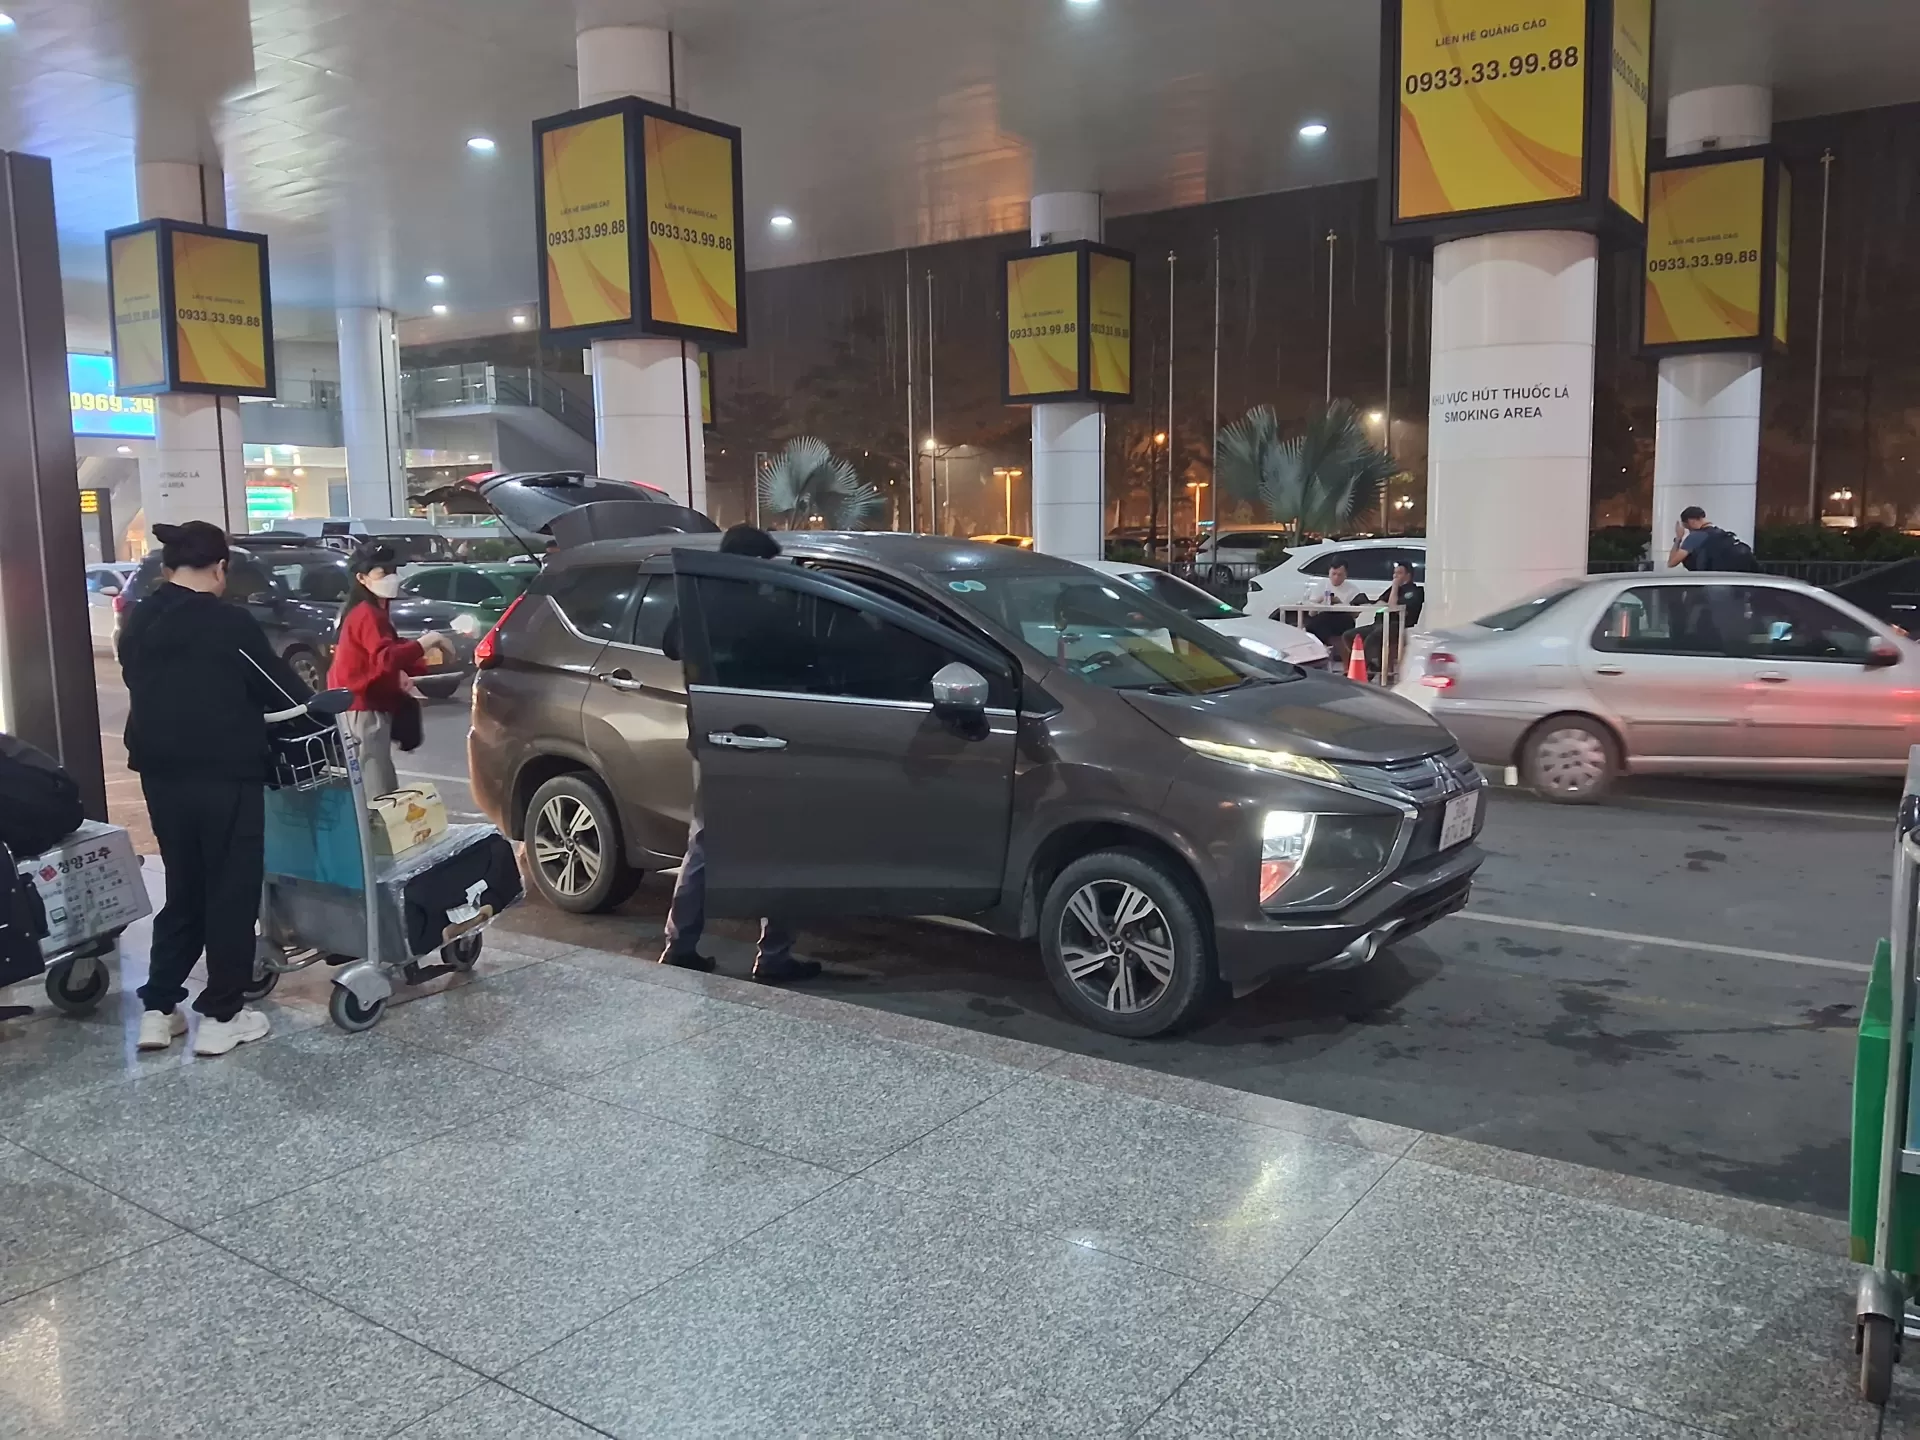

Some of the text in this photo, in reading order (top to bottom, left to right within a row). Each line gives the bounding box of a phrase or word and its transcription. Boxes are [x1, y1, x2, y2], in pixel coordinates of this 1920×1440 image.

[1405, 46, 1579, 94] 0933.33.99.88
[548, 219, 625, 246] 0933.33.99.88
[650, 220, 732, 251] 0933.33.99.88
[1649, 249, 1758, 272] 0933.33.99.88
[178, 308, 260, 327] 0933.33.99.88
[1010, 322, 1076, 340] 0933.33.99.88
[1446, 390, 1468, 406] VỰC
[1472, 386, 1499, 402] HÚT
[1502, 382, 1550, 400] THUỐC
[1444, 406, 1543, 423] SMOKING AREA
[58, 846, 112, 874] 청양고추
